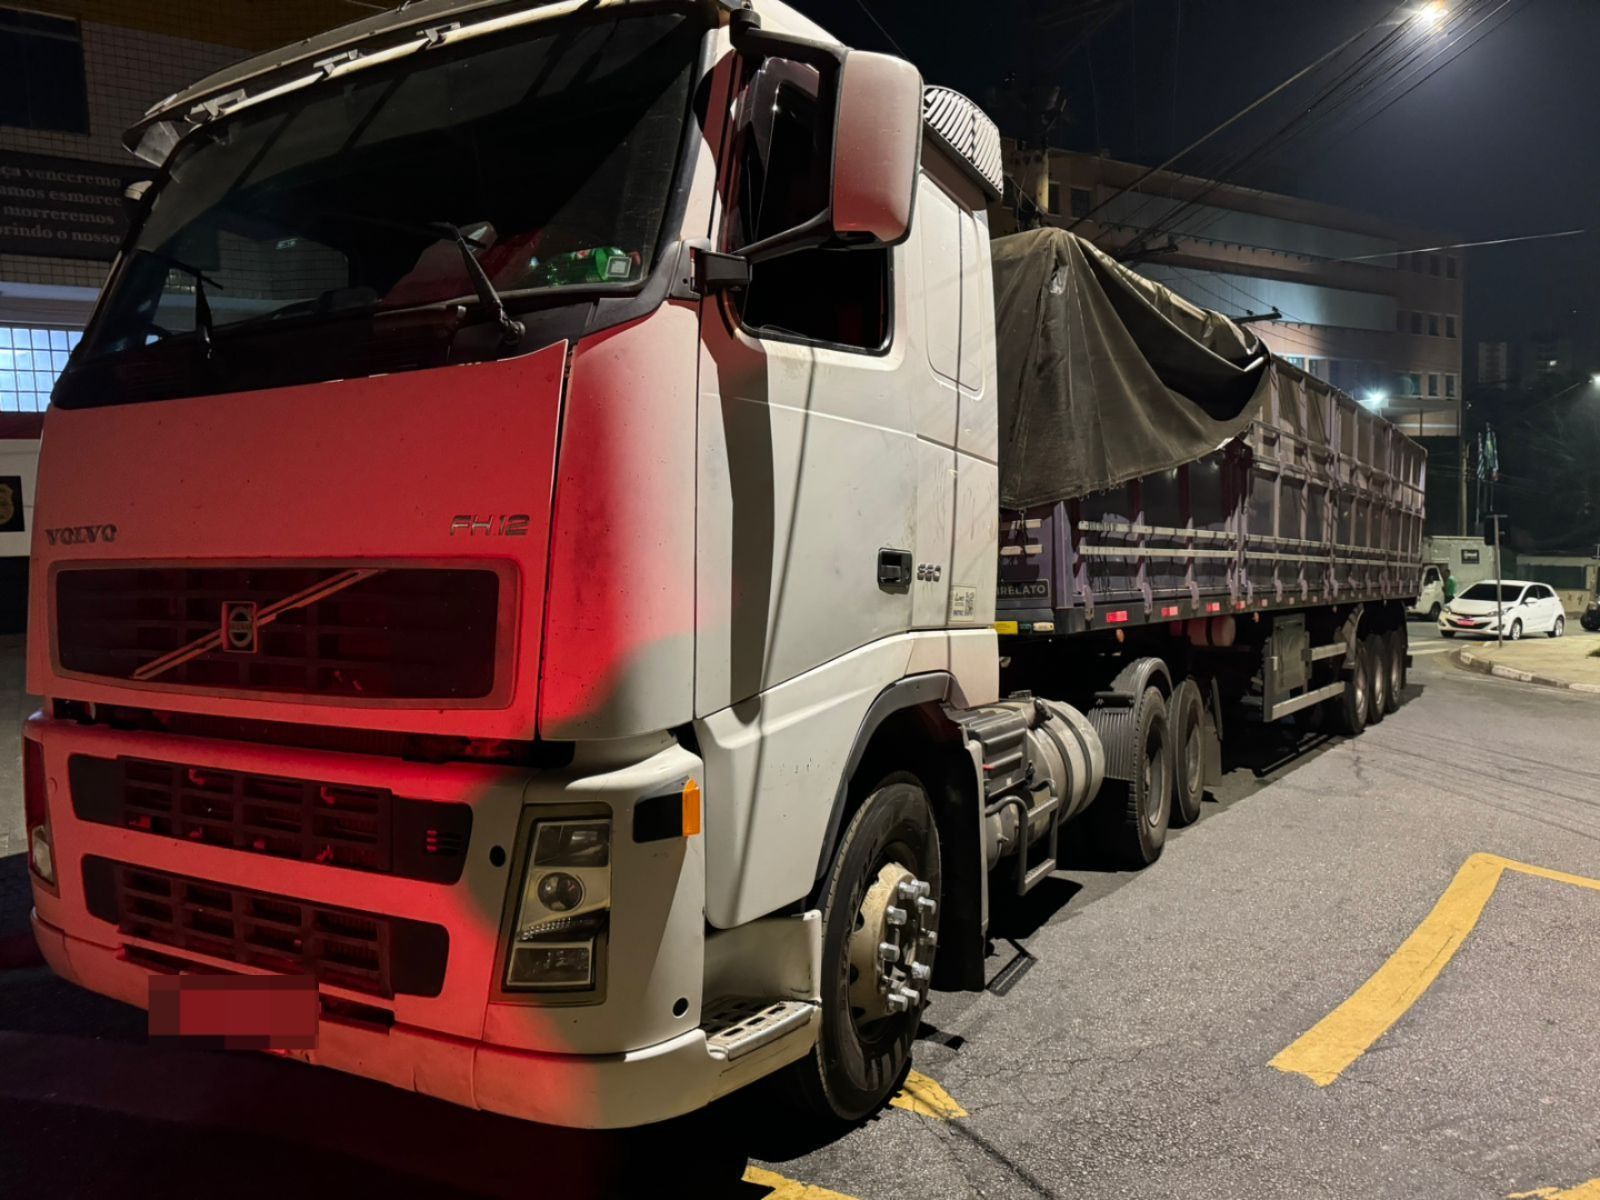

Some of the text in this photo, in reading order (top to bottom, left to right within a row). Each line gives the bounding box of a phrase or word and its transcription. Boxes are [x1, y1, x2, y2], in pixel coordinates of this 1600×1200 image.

[3, 204, 115, 224] morreremos
[0, 221, 120, 244] rindo o nosso
[45, 524, 117, 546] VOLVO
